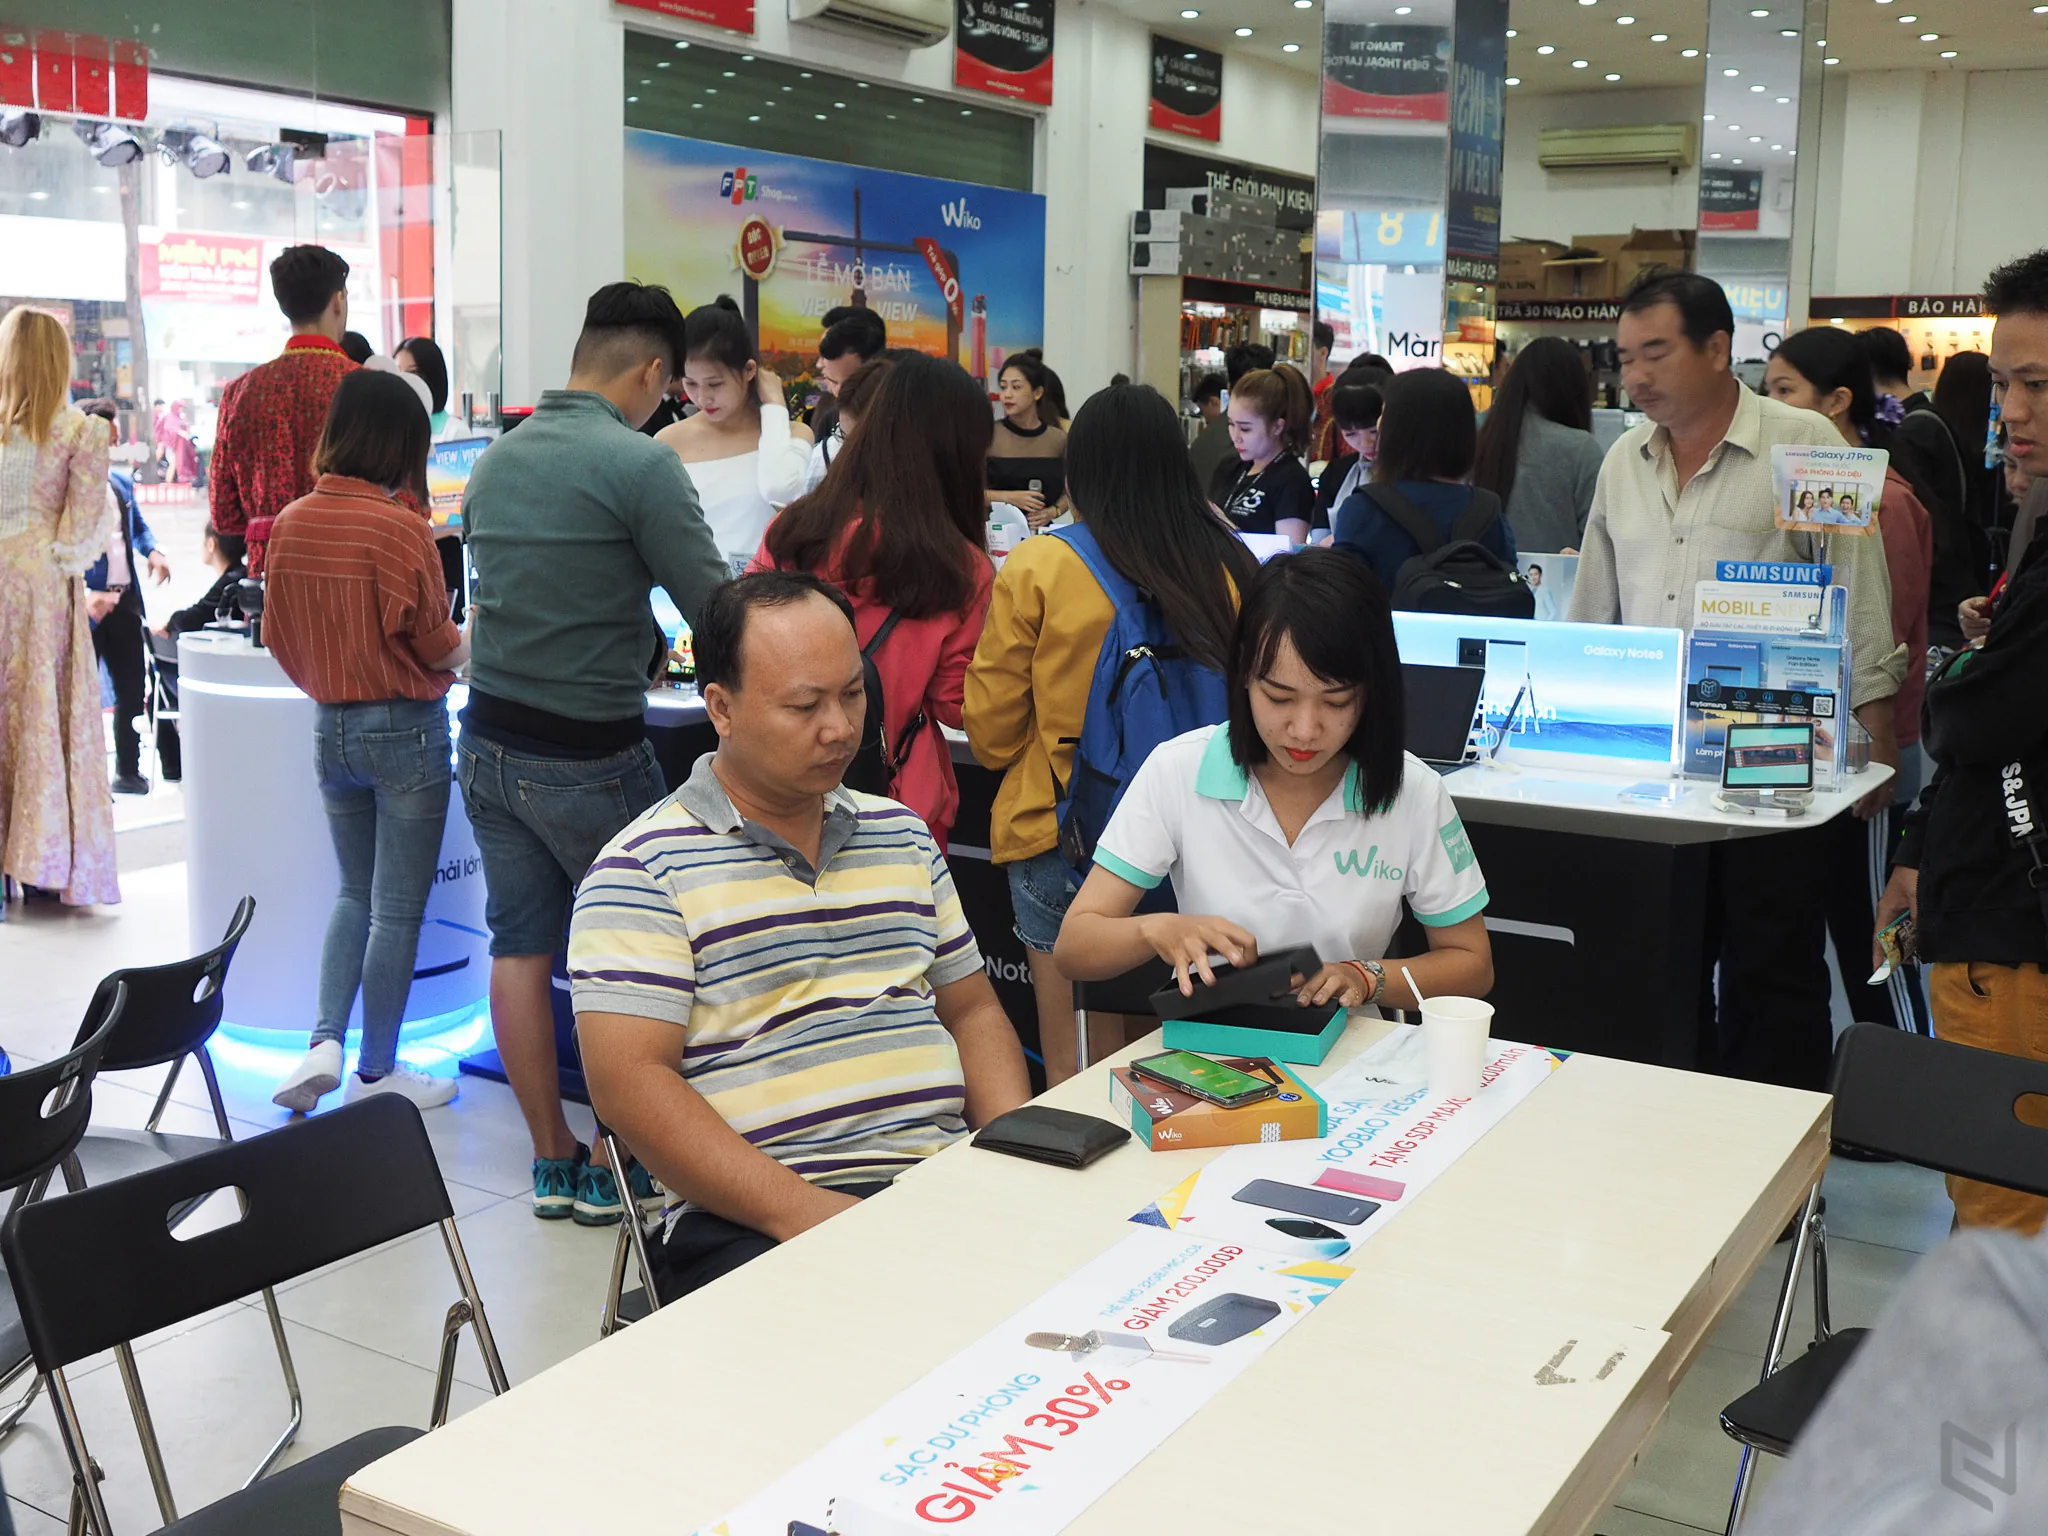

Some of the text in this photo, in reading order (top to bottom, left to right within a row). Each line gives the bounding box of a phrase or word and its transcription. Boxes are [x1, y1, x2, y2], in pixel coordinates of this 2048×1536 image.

[721, 170, 757, 202] FPT
[1206, 170, 1231, 191] THẾ
[1260, 182, 1285, 210] PHỤ
[1287, 188, 1314, 214] KIỆN
[941, 197, 981, 230] Wiko
[806, 253, 911, 292] LỄ MỞ BÁN
[943, 278, 959, 303] 0
[876, 301, 918, 321] VIEW
[1498, 303, 1522, 317] TRẢ
[1525, 304, 1540, 317] 30
[1908, 297, 1945, 314] BẢO
[436, 451, 458, 465] VIEW
[1810, 450, 1845, 461] Galaxy
[1846, 452, 1856, 460] J7
[1857, 452, 1873, 461] Pro
[1782, 590, 1825, 600] SAMSUN
[1702, 599, 1772, 617] MOBILE
[1584, 645, 1663, 660] Galaxy Note8
[1690, 701, 1727, 710] mySamsung
[1695, 747, 1713, 756] Làm
[1333, 845, 1403, 881] Wiko
[1158, 1128, 1183, 1140] Wiko
[1316, 1117, 1390, 1164] YOOBAO
[1369, 1140, 1419, 1168] TẶNG
[1405, 1121, 1440, 1141] SDP
[1123, 1244, 1244, 1331] GIẢM 200.000Đ
[879, 1372, 1042, 1487] SẠC DỰ PHÒNG
[915, 1370, 1131, 1524] GIẢM 30%
